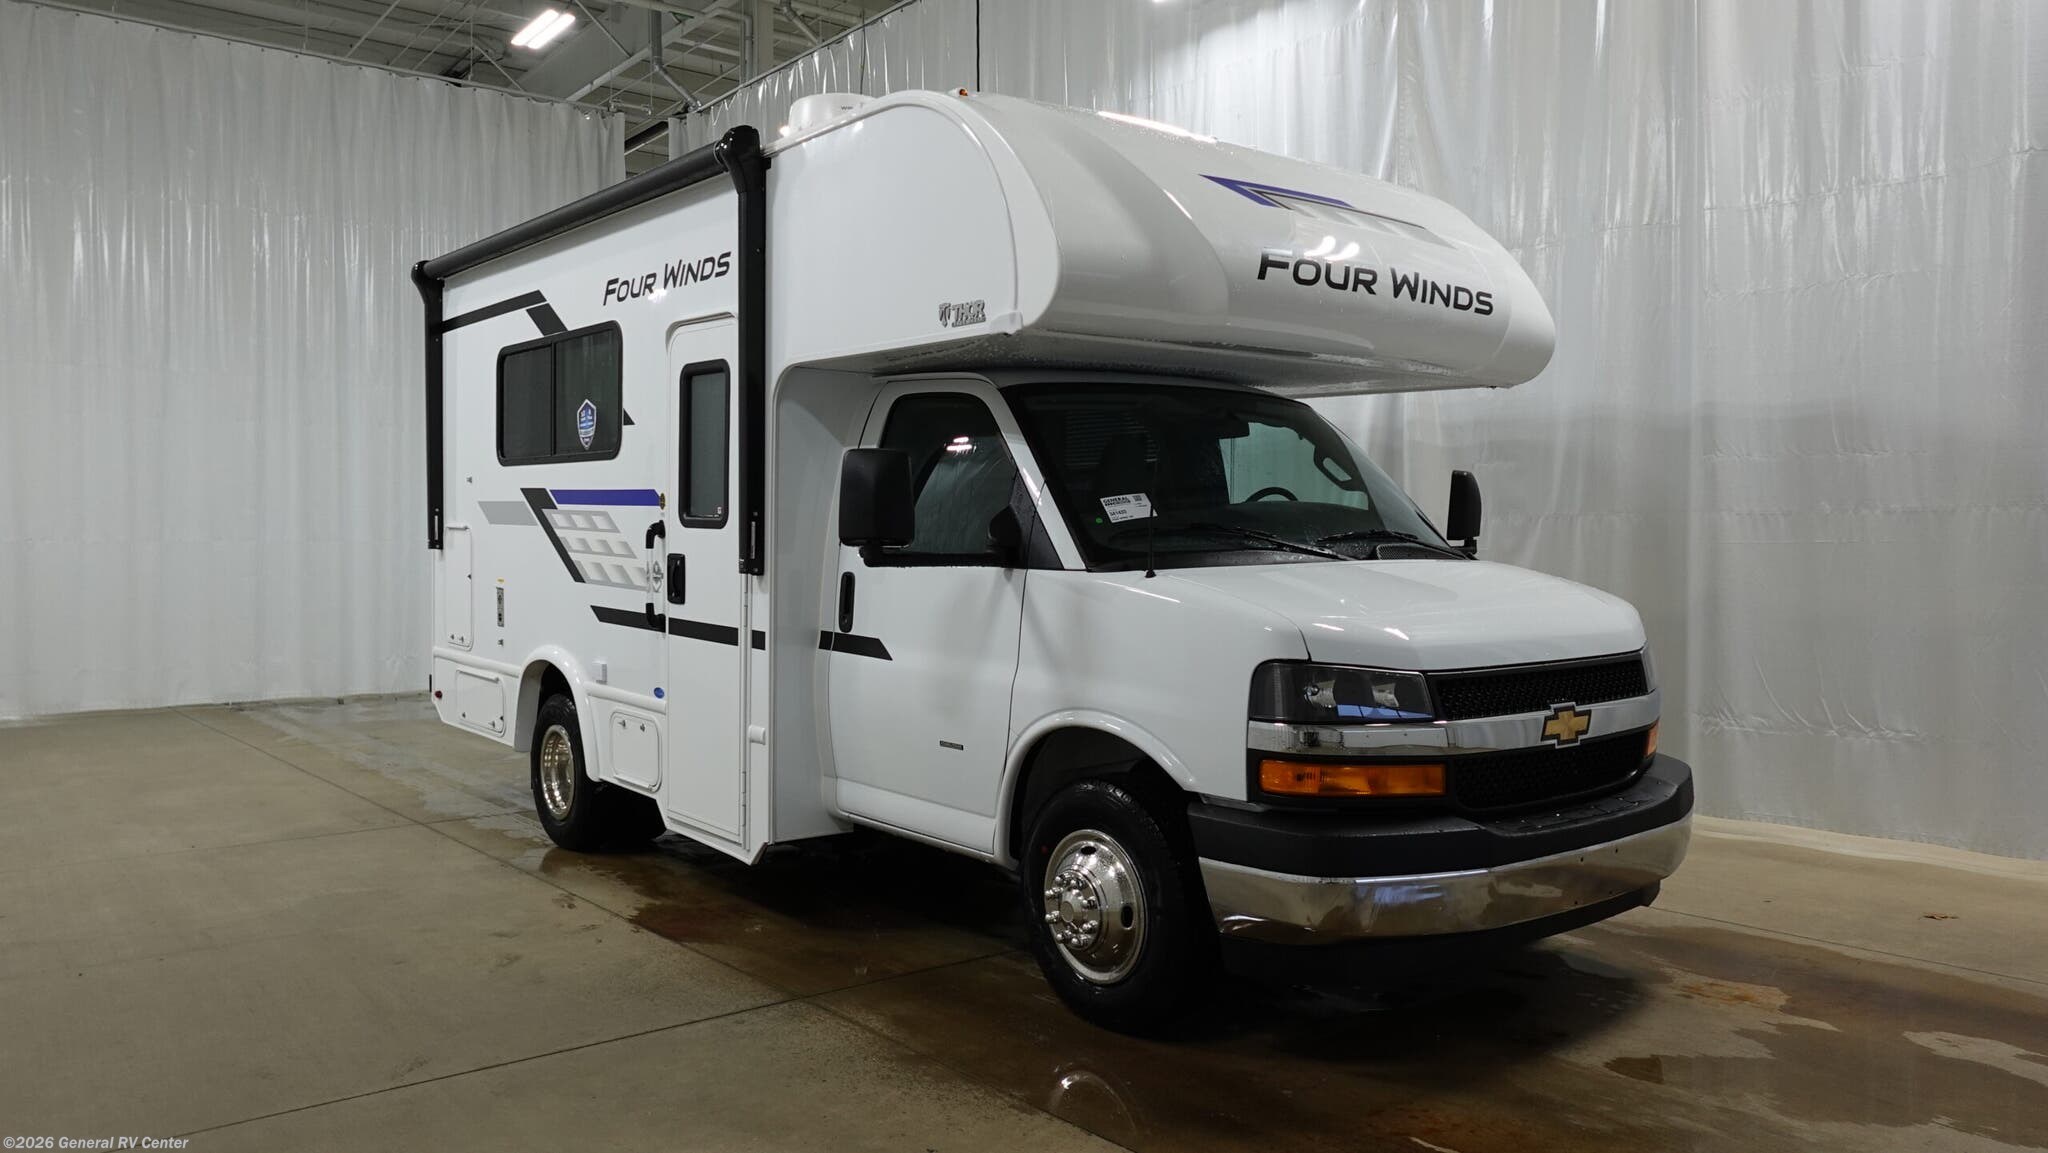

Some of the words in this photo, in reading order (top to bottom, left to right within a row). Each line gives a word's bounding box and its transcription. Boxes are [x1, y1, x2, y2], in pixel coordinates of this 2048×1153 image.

[603, 272, 657, 306] FOUR
[663, 251, 731, 290] WINDS
[1257, 249, 1378, 295] FOUR
[1390, 267, 1494, 316] WINDS
[952, 300, 986, 322] THOR
